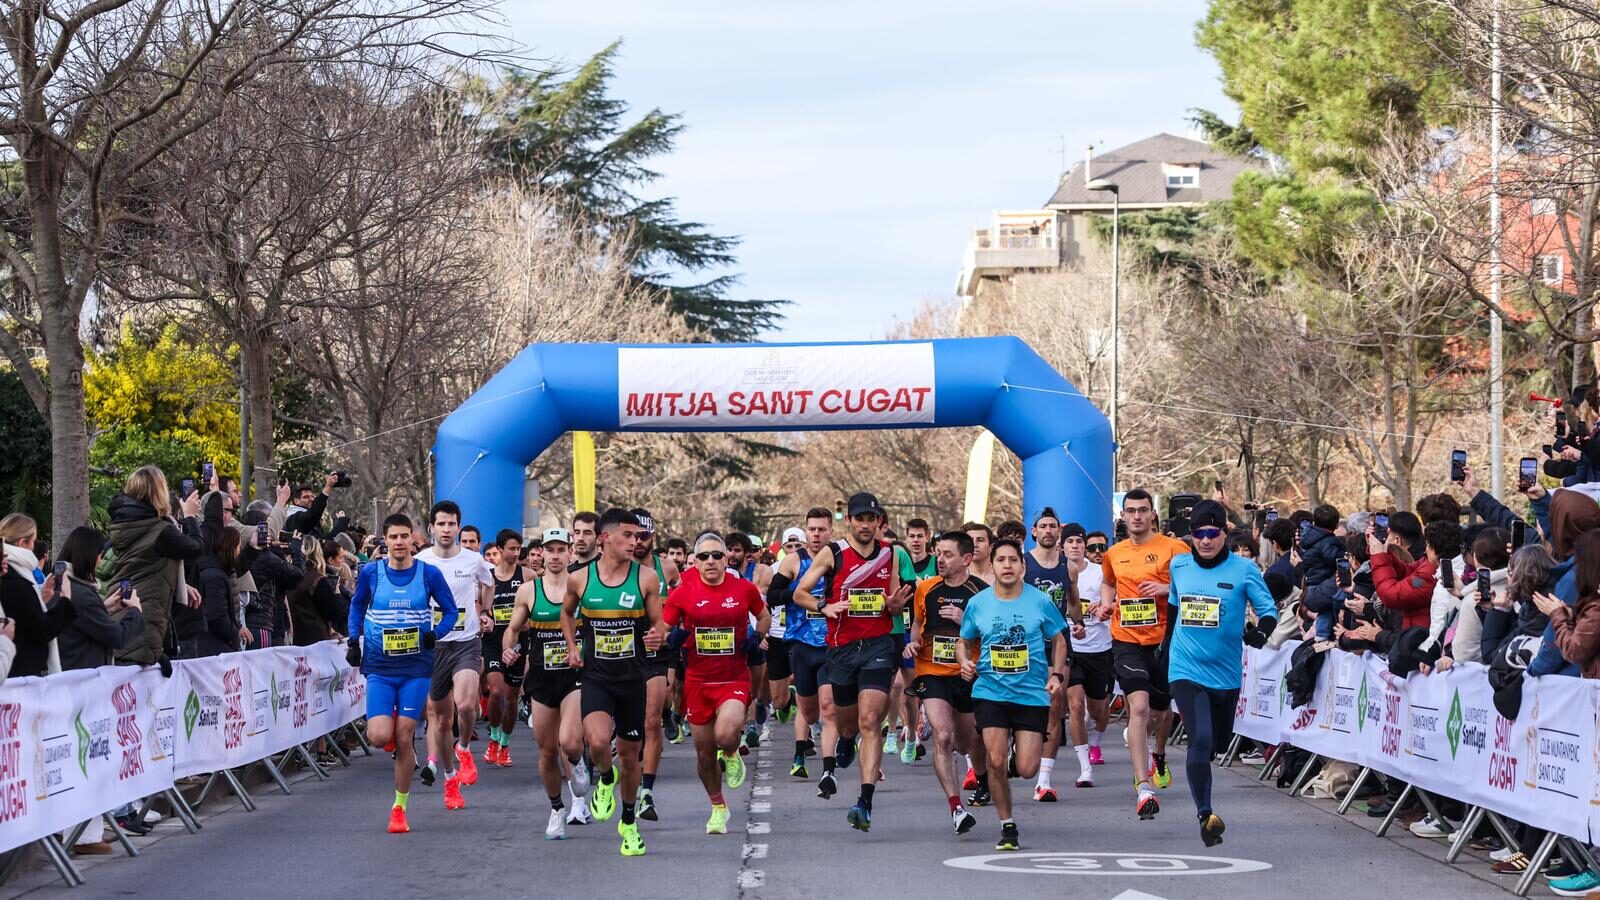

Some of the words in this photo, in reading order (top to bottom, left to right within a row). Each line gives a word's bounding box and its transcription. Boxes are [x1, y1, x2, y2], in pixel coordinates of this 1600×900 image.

[626, 392, 718, 417] MITJA
[728, 391, 813, 416] SANT
[818, 387, 932, 414] CUGAT
[1125, 604, 1149, 612] GUILLEM
[1187, 603, 1210, 611] MIQUEL
[387, 633, 415, 641] FRANCESC
[1382, 725, 1401, 758] CUGAT
[1540, 737, 1550, 756] CLUB
[1489, 752, 1517, 792] CUGAT
[1538, 762, 1550, 781] SANT
[1551, 765, 1566, 784] CUGAT
[1029, 857, 1190, 870] 30
